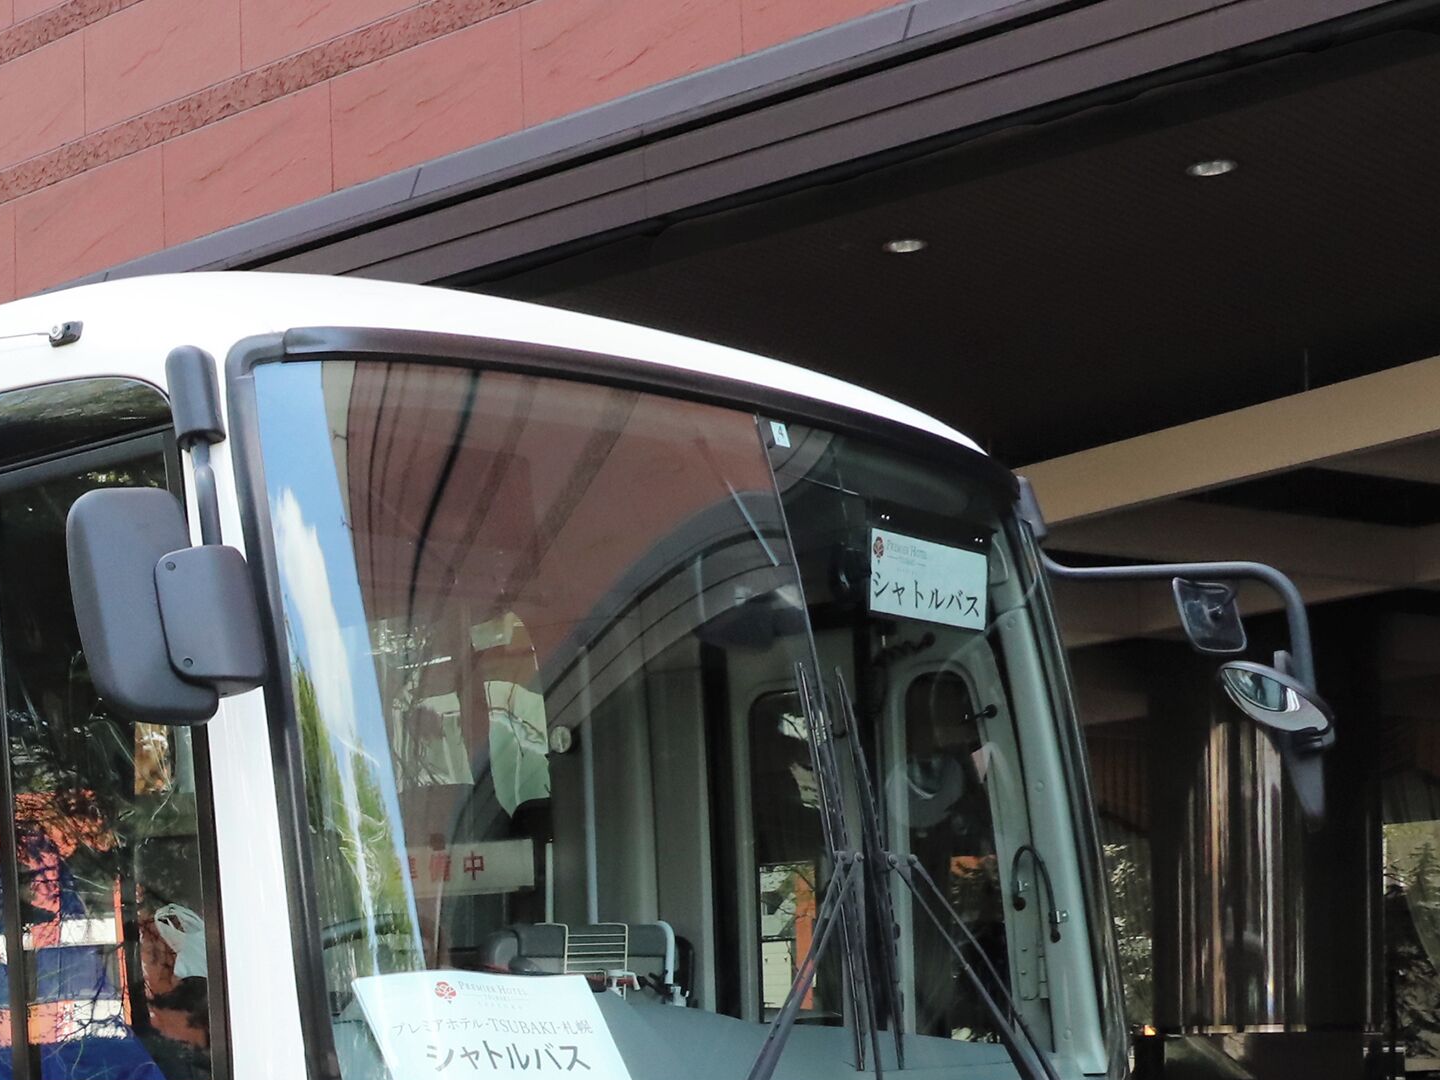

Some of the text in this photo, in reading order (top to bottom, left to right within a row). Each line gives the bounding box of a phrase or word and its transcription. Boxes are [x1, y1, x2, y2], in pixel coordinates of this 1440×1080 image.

[872, 571, 980, 617] シャトルバス
[426, 1040, 591, 1071] シャトルバス
